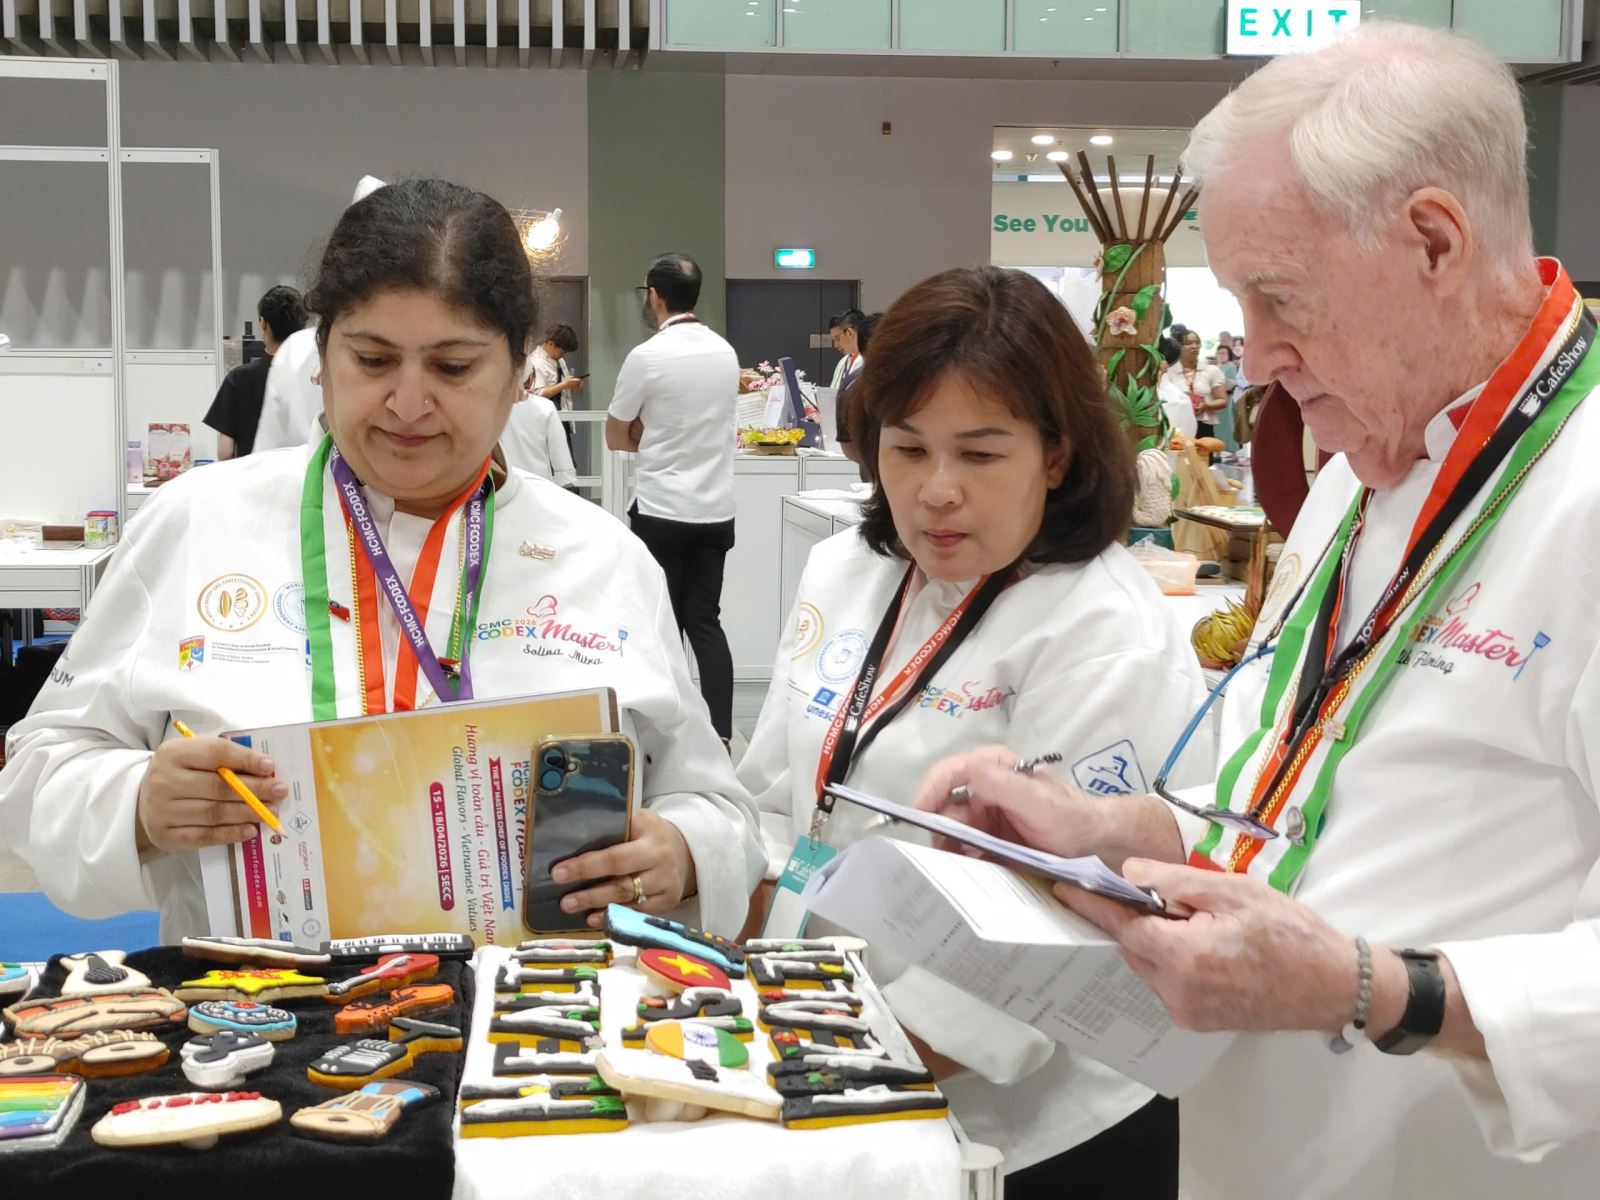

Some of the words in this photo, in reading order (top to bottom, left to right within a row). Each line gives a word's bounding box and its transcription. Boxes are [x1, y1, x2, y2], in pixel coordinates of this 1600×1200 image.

[1240, 8, 1347, 36] EXIT
[993, 214, 1037, 232] See
[1042, 214, 1089, 232] You
[1536, 335, 1588, 397] CafeShow
[361, 521, 383, 556] HCMC
[403, 613, 425, 648] HCMC
[475, 619, 512, 631] CMC
[540, 619, 619, 652] Master
[934, 610, 963, 641] HCMC
[1432, 616, 1528, 667] Master
[850, 664, 877, 716] CafeShow
[806, 703, 836, 722] unesc
[452, 746, 464, 781] Global
[433, 790, 443, 803] 15
[456, 785, 468, 823] Flavors
[1088, 778, 1131, 795] ITP
[435, 811, 449, 868] 18/04/2026
[461, 834, 475, 894] Vietnamese
[441, 874, 452, 901] SECC
[466, 897, 478, 932] Values
